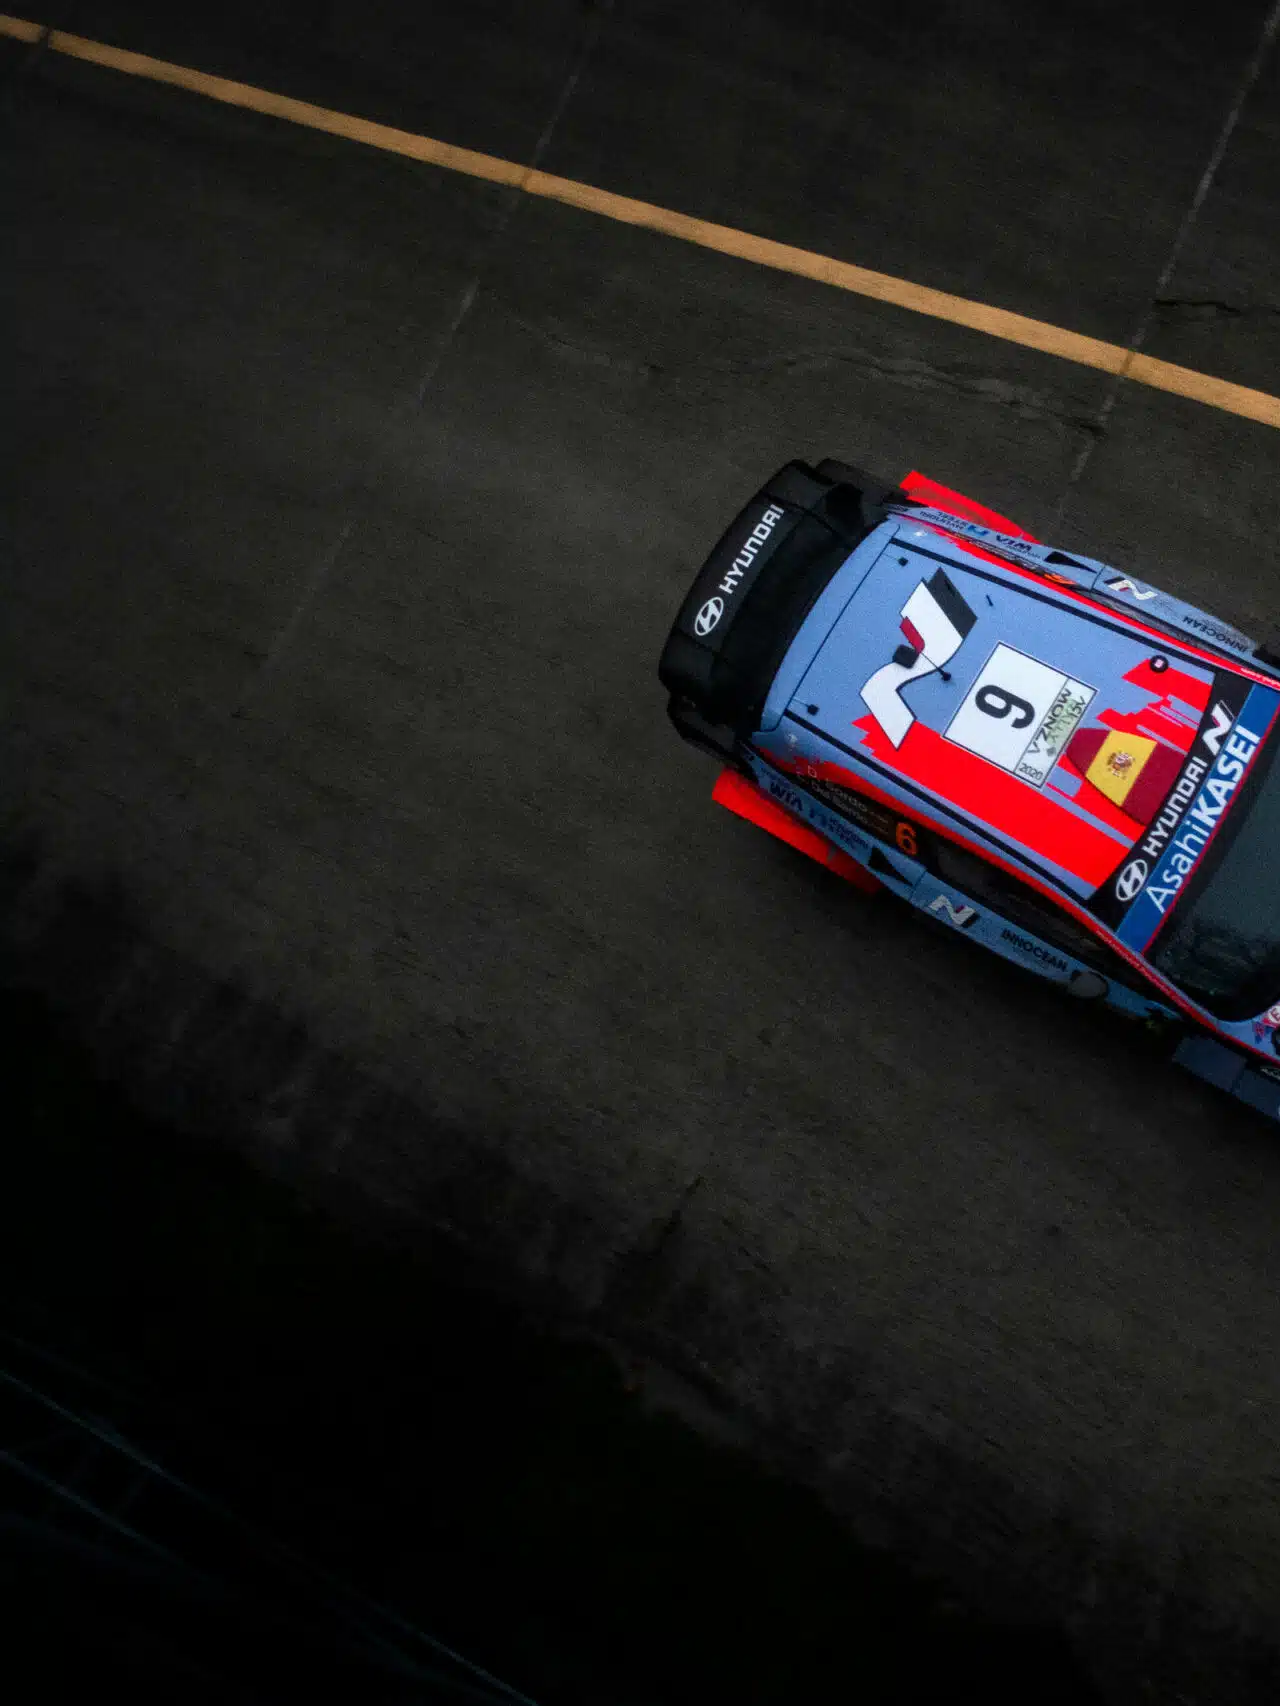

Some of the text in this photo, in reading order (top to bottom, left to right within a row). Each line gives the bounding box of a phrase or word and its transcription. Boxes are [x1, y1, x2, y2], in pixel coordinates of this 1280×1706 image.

[718, 503, 784, 595] HYUNDAI
[1182, 615, 1248, 653] INNOCEAN
[975, 684, 1035, 729] 6
[1018, 762, 1043, 780] 2020
[1142, 755, 1208, 857] HYUNDAI
[896, 821, 919, 856] 6
[1001, 929, 1068, 972] INNOCEAN
